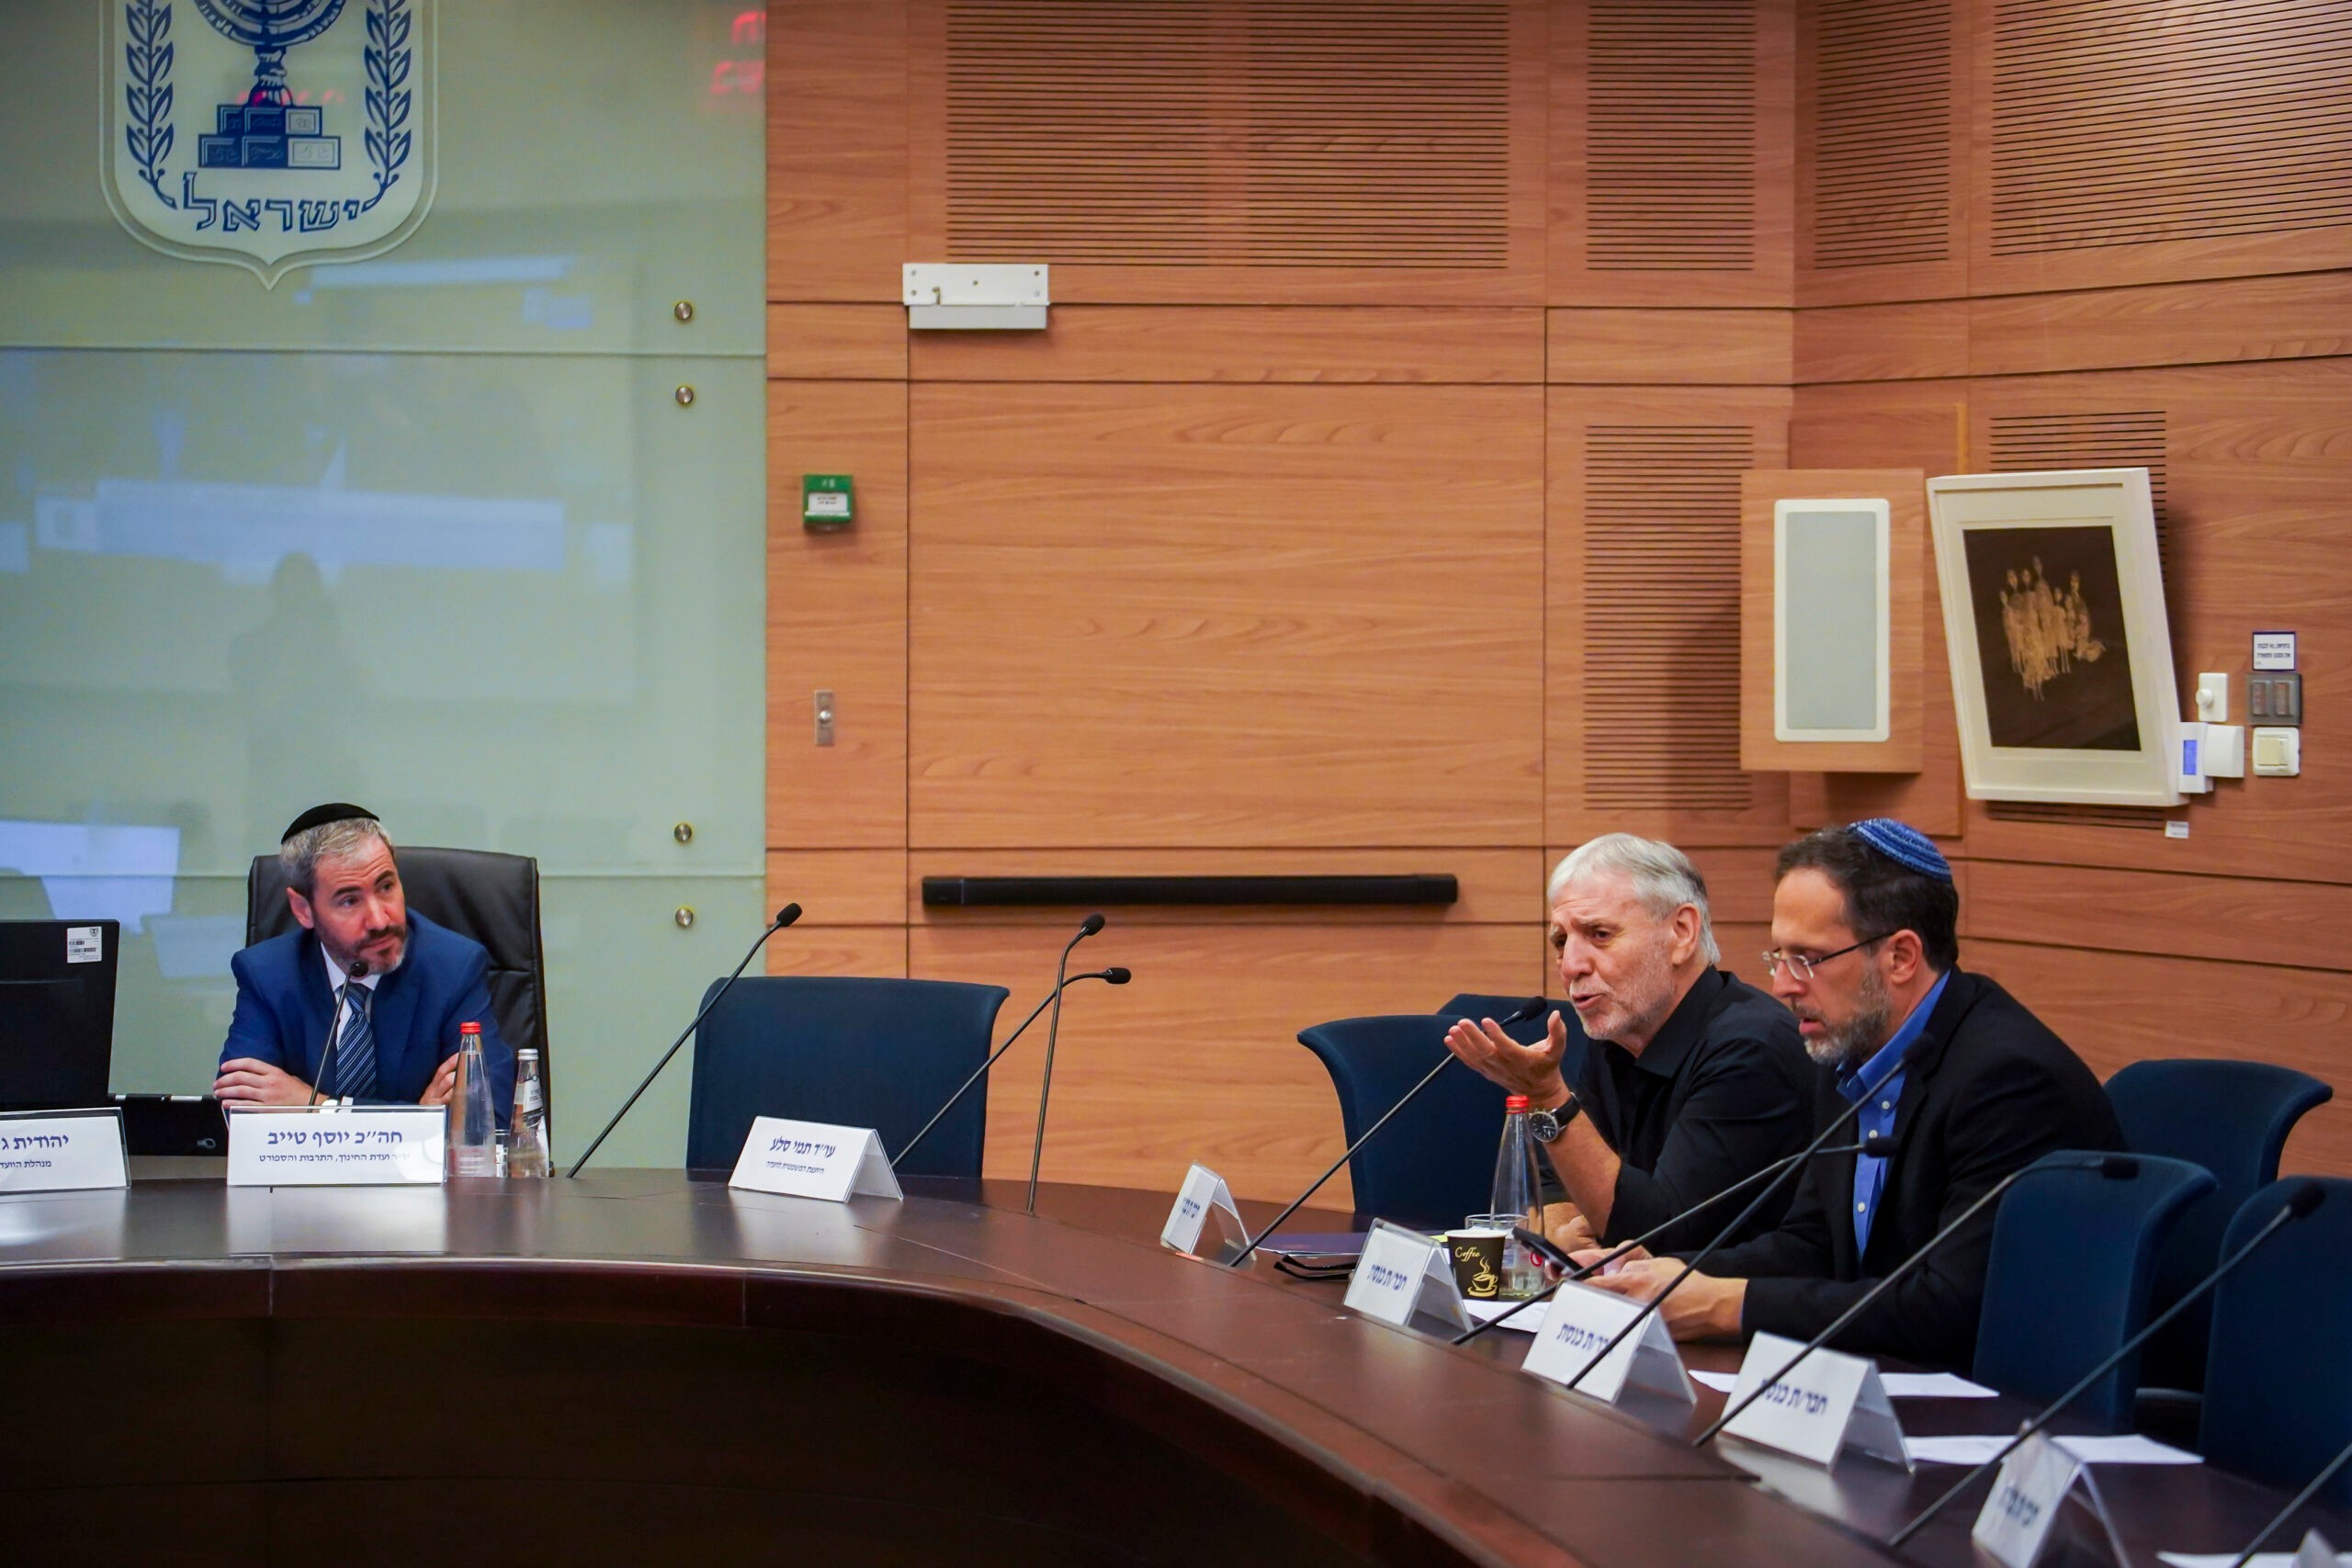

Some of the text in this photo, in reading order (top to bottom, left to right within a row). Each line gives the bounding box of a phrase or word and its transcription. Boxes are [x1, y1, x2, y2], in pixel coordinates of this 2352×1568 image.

[183, 171, 360, 232] ישראל
[14, 1134, 69, 1150] יהודית
[267, 1131, 307, 1145] טייב
[312, 1131, 350, 1147] יוסף
[769, 1135, 792, 1152] סלע
[793, 1141, 812, 1155] תמי
[24, 1159, 52, 1168] מנהלת
[259, 1154, 297, 1162] והספורט
[300, 1154, 334, 1162] התרבות
[335, 1154, 367, 1163] החינוך,
[1454, 1247, 1481, 1262] Coffee
[1556, 1324, 1584, 1347] כנסת
